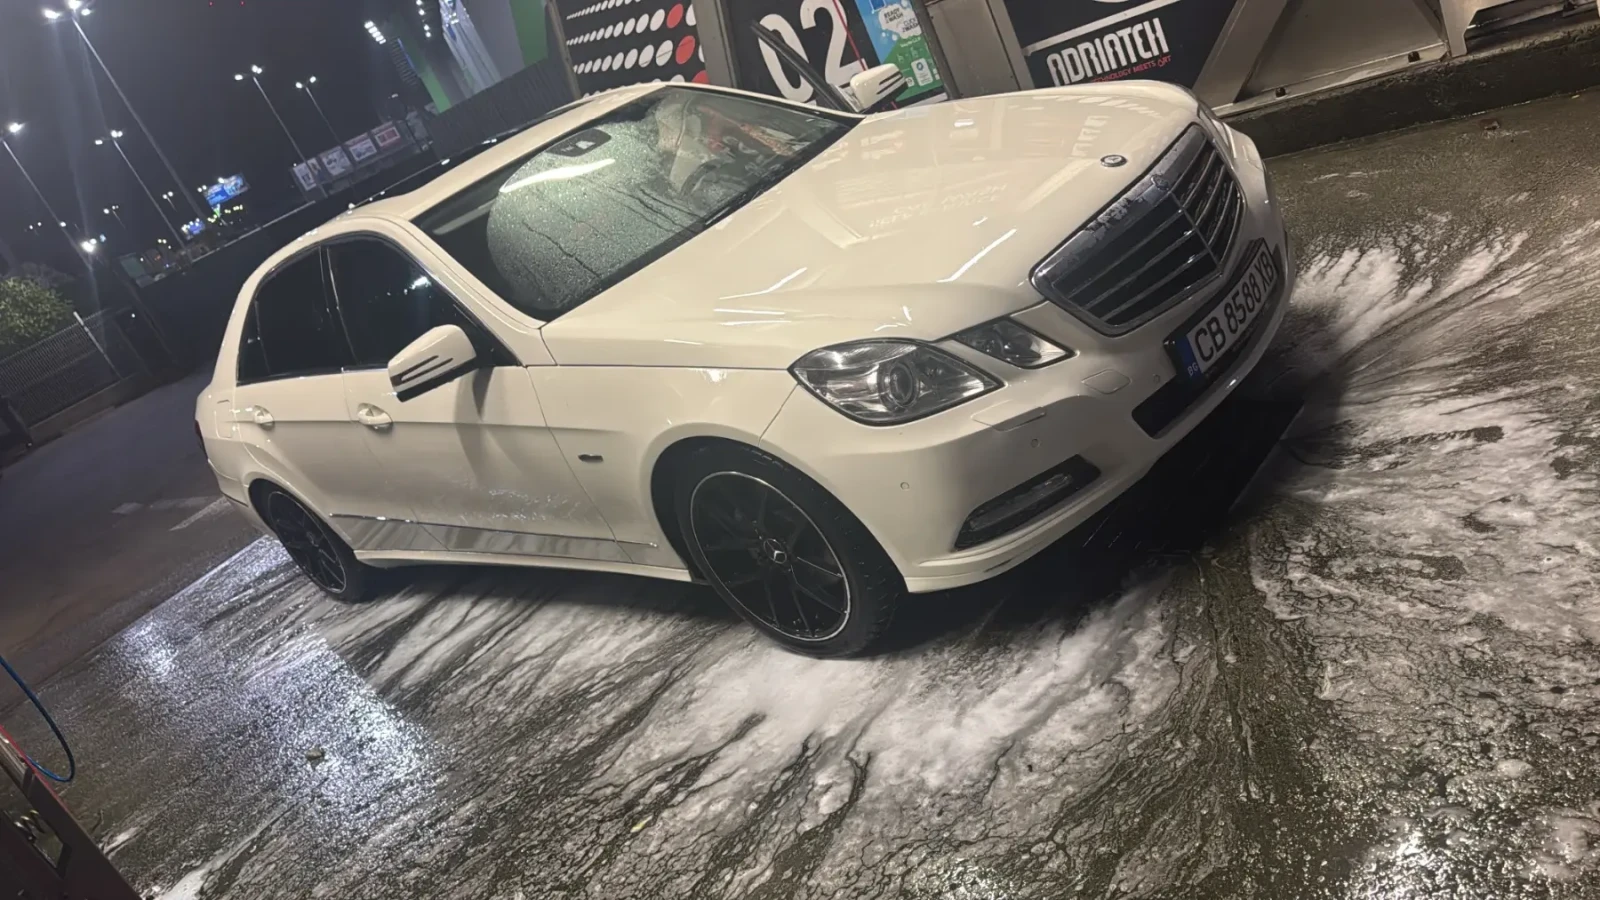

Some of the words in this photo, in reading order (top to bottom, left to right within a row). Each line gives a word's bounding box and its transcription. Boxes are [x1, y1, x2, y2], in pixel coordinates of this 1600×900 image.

[884, 7, 900, 18] READY
[758, 0, 868, 103] 02
[1046, 17, 1169, 87] ADRIATCH
[1133, 60, 1156, 73] MEETS
[1194, 316, 1227, 363] CB
[1223, 272, 1262, 335] 8588
[1254, 250, 1275, 293] XB
[1187, 361, 1199, 377] BG
